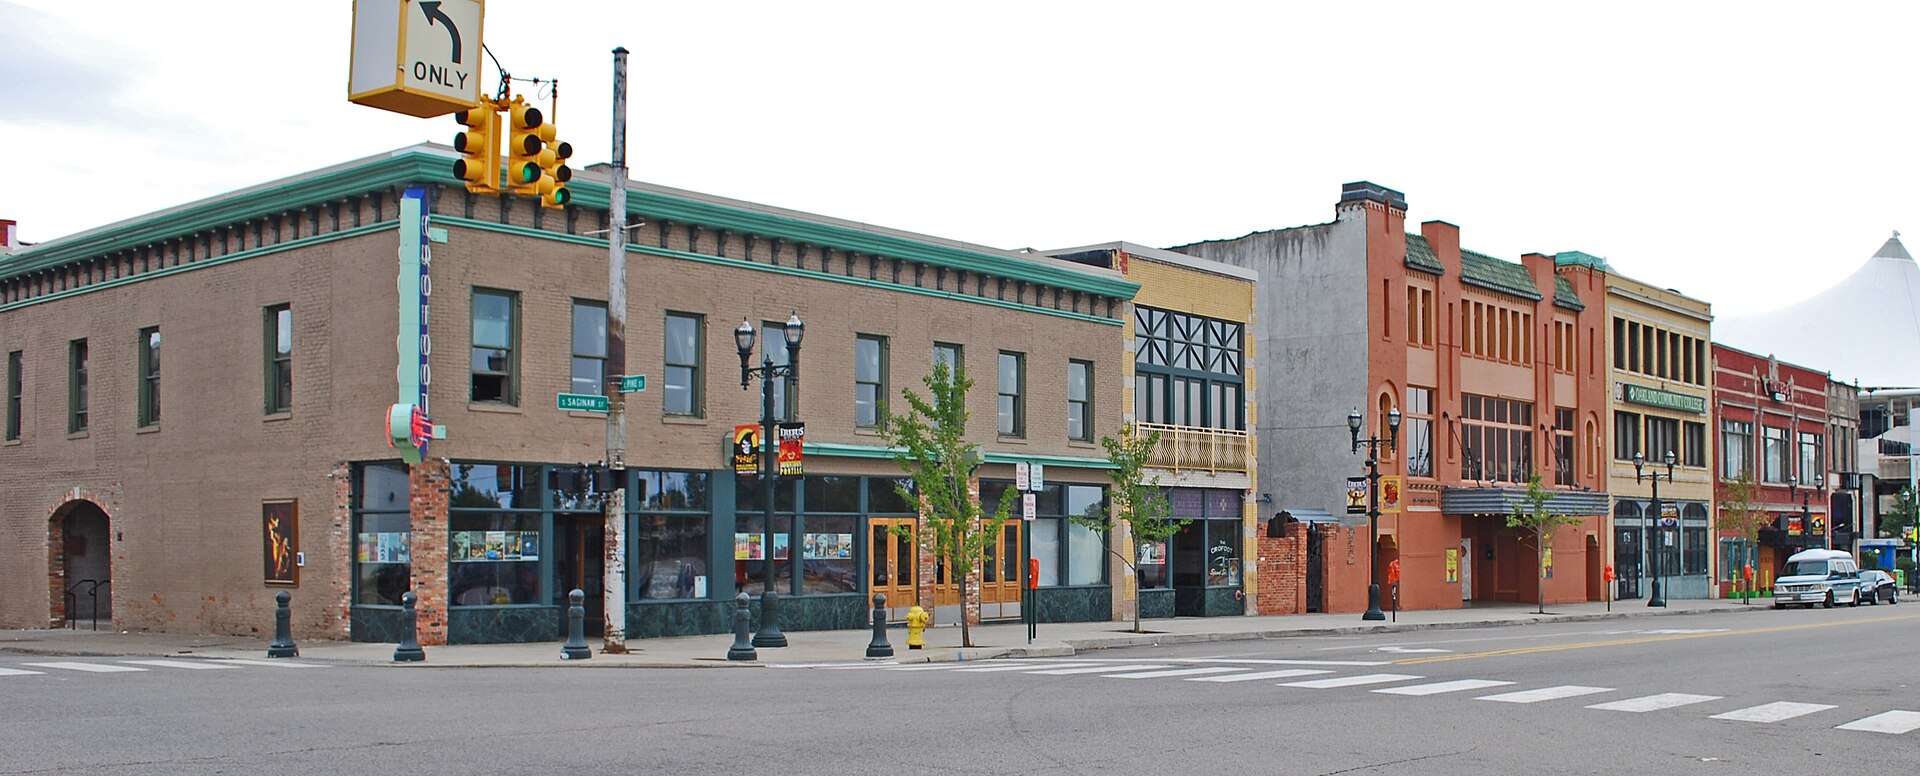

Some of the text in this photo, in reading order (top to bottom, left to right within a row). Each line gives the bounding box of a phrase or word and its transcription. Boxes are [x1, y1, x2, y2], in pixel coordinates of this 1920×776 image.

[413, 61, 469, 90] ONLY
[567, 397, 595, 408] SAGINAW
[1635, 387, 1658, 404] OAKLAND
